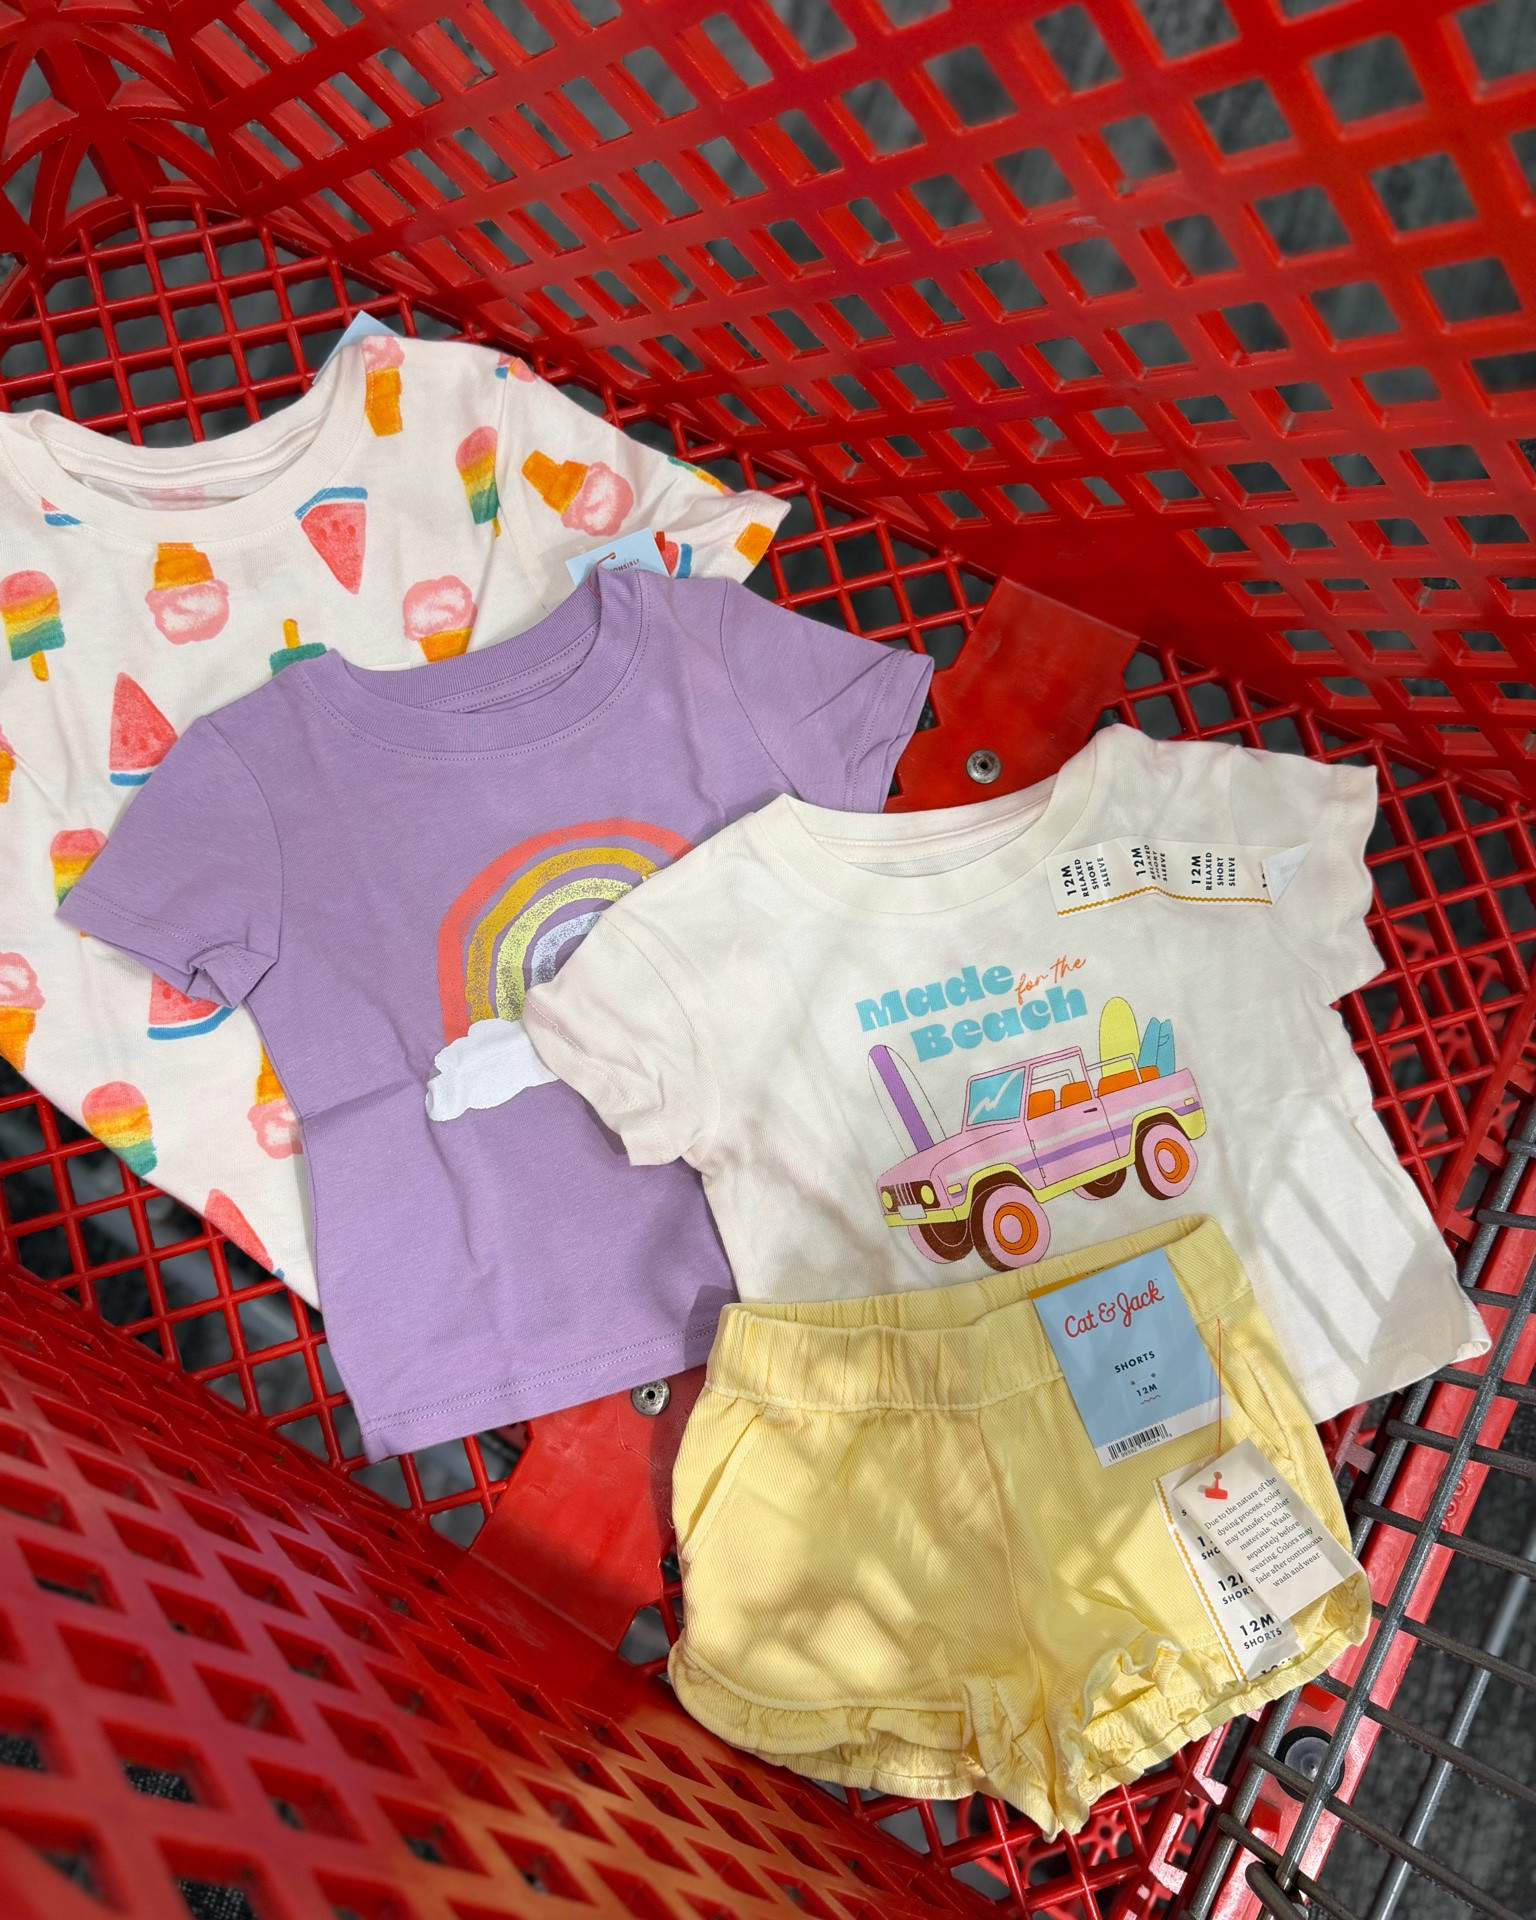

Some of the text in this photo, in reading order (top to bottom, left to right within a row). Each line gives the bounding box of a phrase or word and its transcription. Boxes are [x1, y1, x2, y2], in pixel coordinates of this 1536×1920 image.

[1074, 859, 1089, 897] RELAXED
[1086, 860, 1099, 890] SHORT
[1097, 857, 1111, 887] SLEEVE
[1131, 847, 1146, 876] 12M
[1144, 844, 1156, 880] RELAXED
[1153, 850, 1161, 879] SHORT
[1160, 853, 1168, 882] SLEEVE
[1191, 855, 1202, 885] 12M
[1205, 852, 1213, 891] RELAXED
[1228, 857, 1236, 887] SLEEVE
[1061, 865, 1077, 896] 12M
[855, 954, 1087, 1033] Made for the
[910, 986, 1088, 1062] Beach
[1064, 1279, 1165, 1338] Cat & Jack
[1114, 1350, 1156, 1373] SHORTS
[1136, 1383, 1158, 1397] 12M
[1204, 1476, 1277, 1530] Due to the nature of the
[1217, 1489, 1281, 1536] dyeing process, color
[1225, 1534, 1239, 1546] may
[1238, 1515, 1265, 1536] transfer
[1263, 1510, 1272, 1518] to
[1271, 1498, 1290, 1513] other
[1239, 1512, 1291, 1551] materials. Wash
[1246, 1521, 1300, 1561] separately before
[1249, 1526, 1313, 1573] wearing. Colors may
[1255, 1535, 1323, 1584] fade after continuous
[1273, 1552, 1323, 1587] wash and wear.
[1222, 1585, 1254, 1605] SHORT
[1239, 1613, 1275, 1636] 12M
[1243, 1627, 1282, 1650] SHORTS
